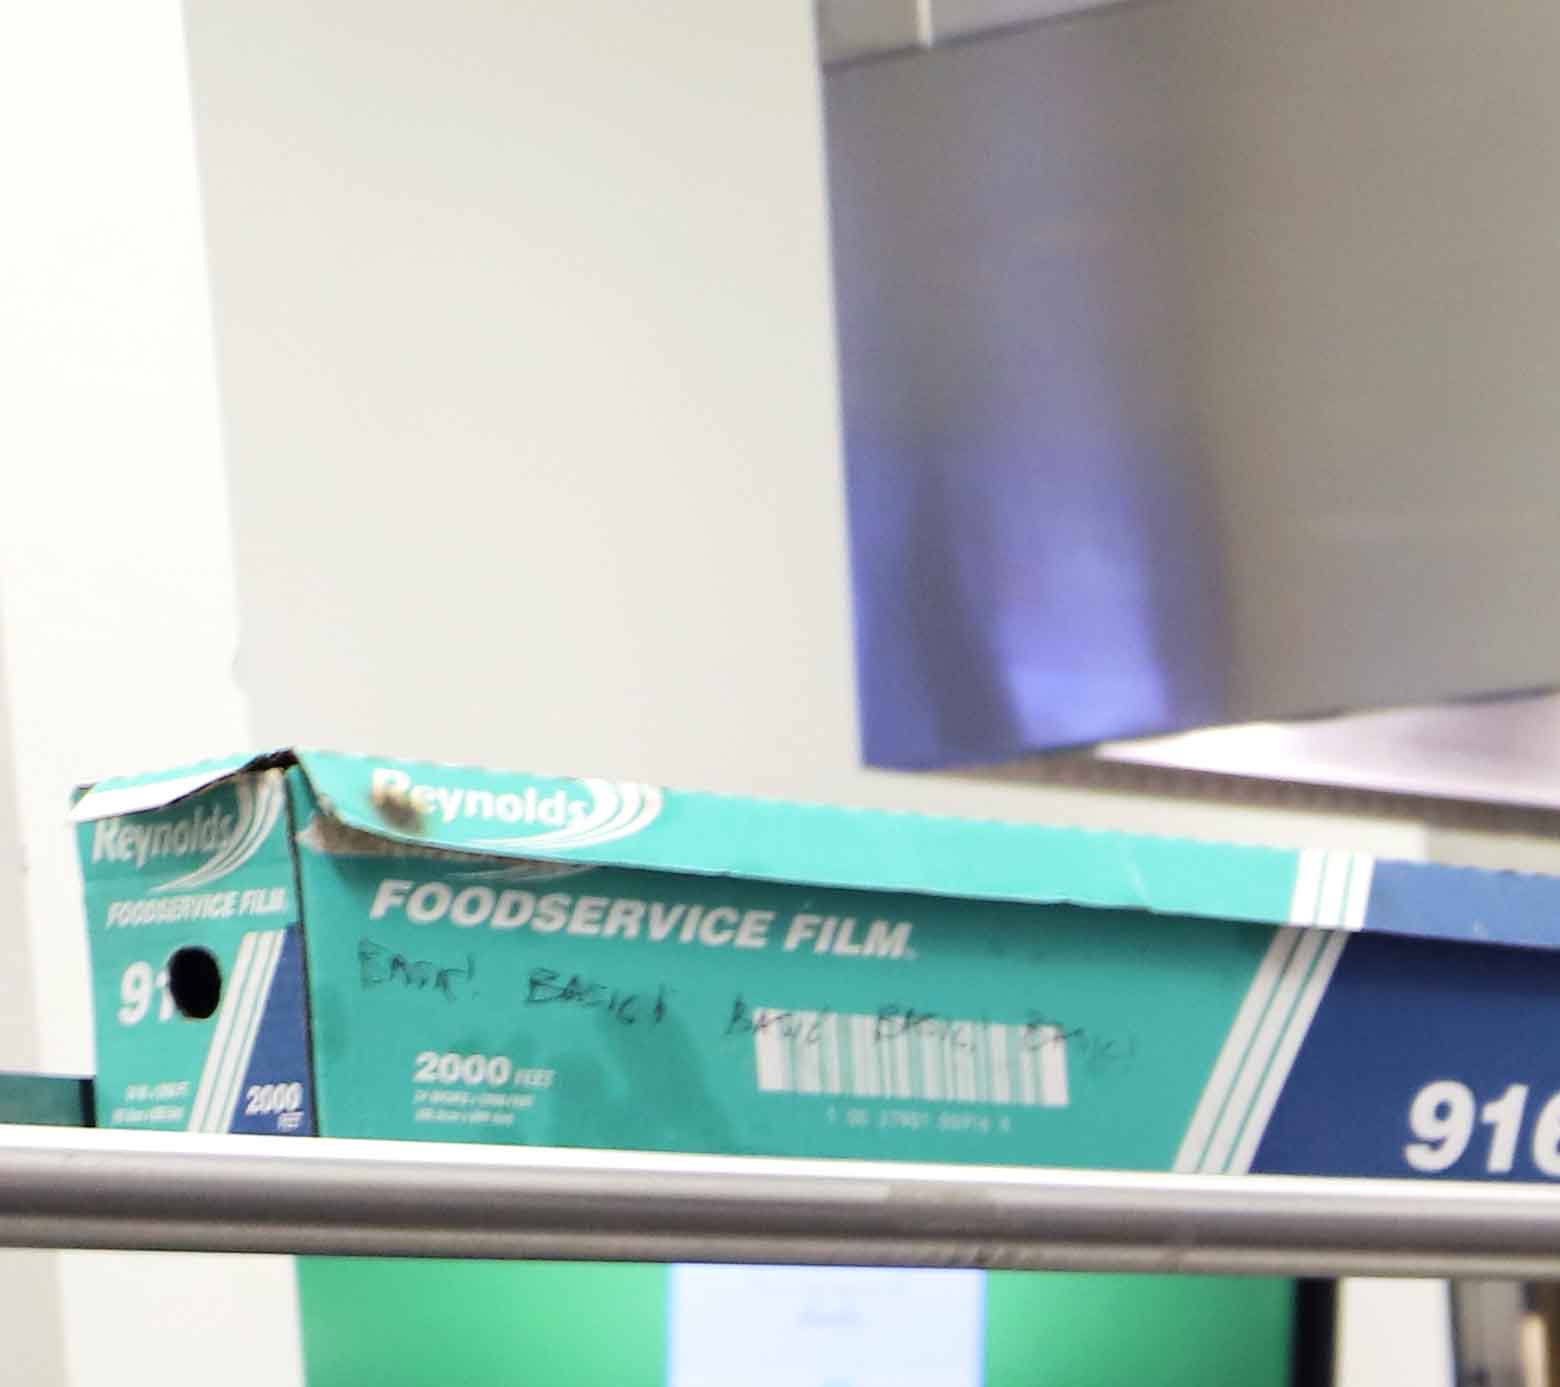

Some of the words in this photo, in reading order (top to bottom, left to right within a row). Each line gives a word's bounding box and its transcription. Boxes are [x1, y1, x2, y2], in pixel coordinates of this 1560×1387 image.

[92, 804, 234, 870] Reynolds
[106, 890, 239, 928] FOODSERVICE
[239, 886, 286, 914] FILM
[368, 879, 775, 949] FOODSERVICE
[117, 960, 175, 1026] 91
[412, 1050, 512, 1086] 2000
[244, 1082, 304, 1116] 2000
